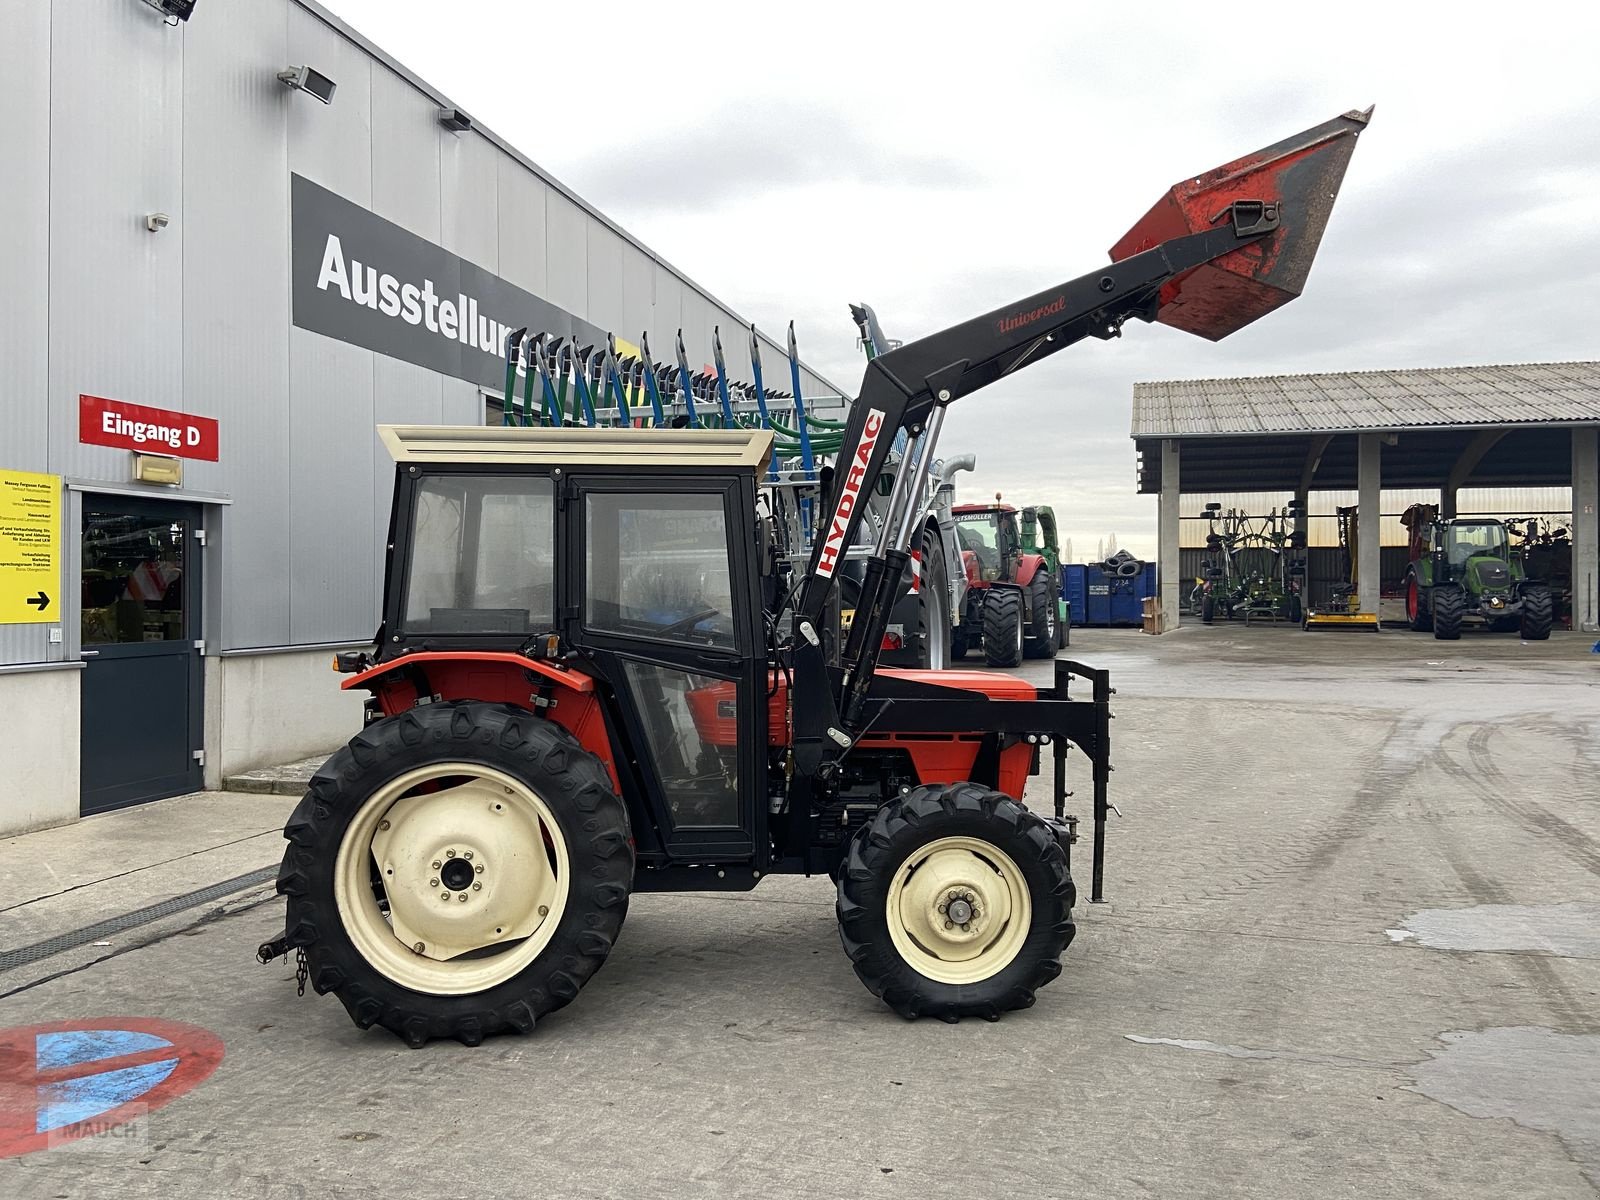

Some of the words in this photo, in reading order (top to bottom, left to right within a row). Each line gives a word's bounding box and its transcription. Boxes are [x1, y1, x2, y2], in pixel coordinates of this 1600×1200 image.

[997, 296, 1066, 333] Universal
[102, 411, 182, 448] Eingang
[187, 426, 201, 446] D
[818, 414, 881, 573] HYDRAC
